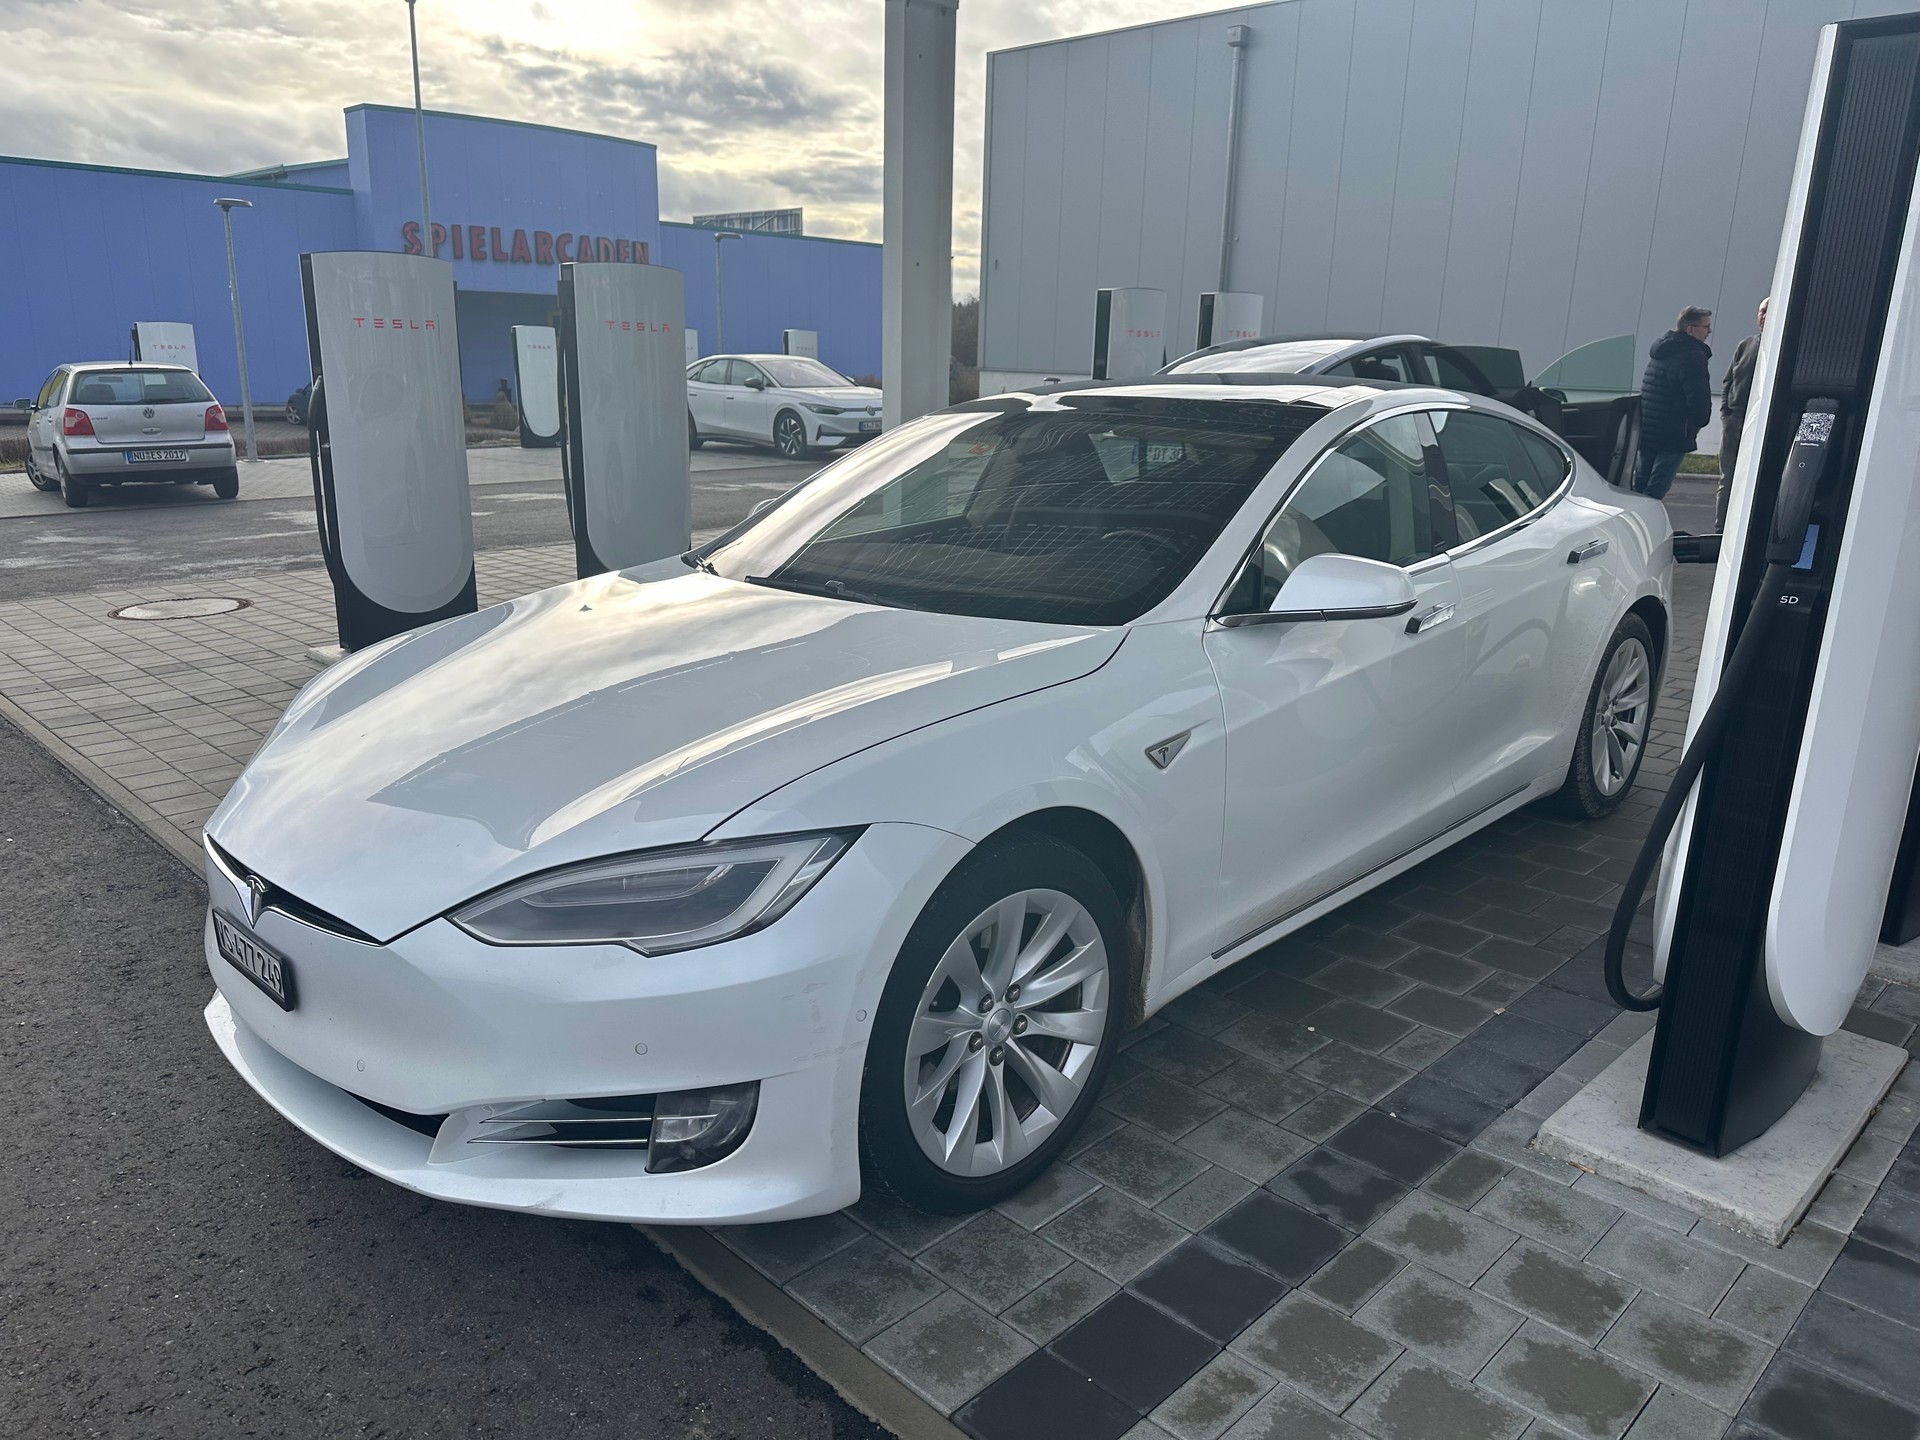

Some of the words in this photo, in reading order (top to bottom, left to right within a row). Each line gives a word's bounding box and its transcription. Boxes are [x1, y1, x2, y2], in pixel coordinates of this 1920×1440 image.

[402, 220, 648, 265] SPIELARCADEN
[353, 317, 435, 330] TESLA
[605, 320, 670, 333] TESLA
[1127, 329, 1161, 338] TESLA
[133, 451, 145, 460] NU
[151, 450, 162, 460] ES
[164, 450, 184, 459] 2017
[1780, 595, 1799, 605] 5D
